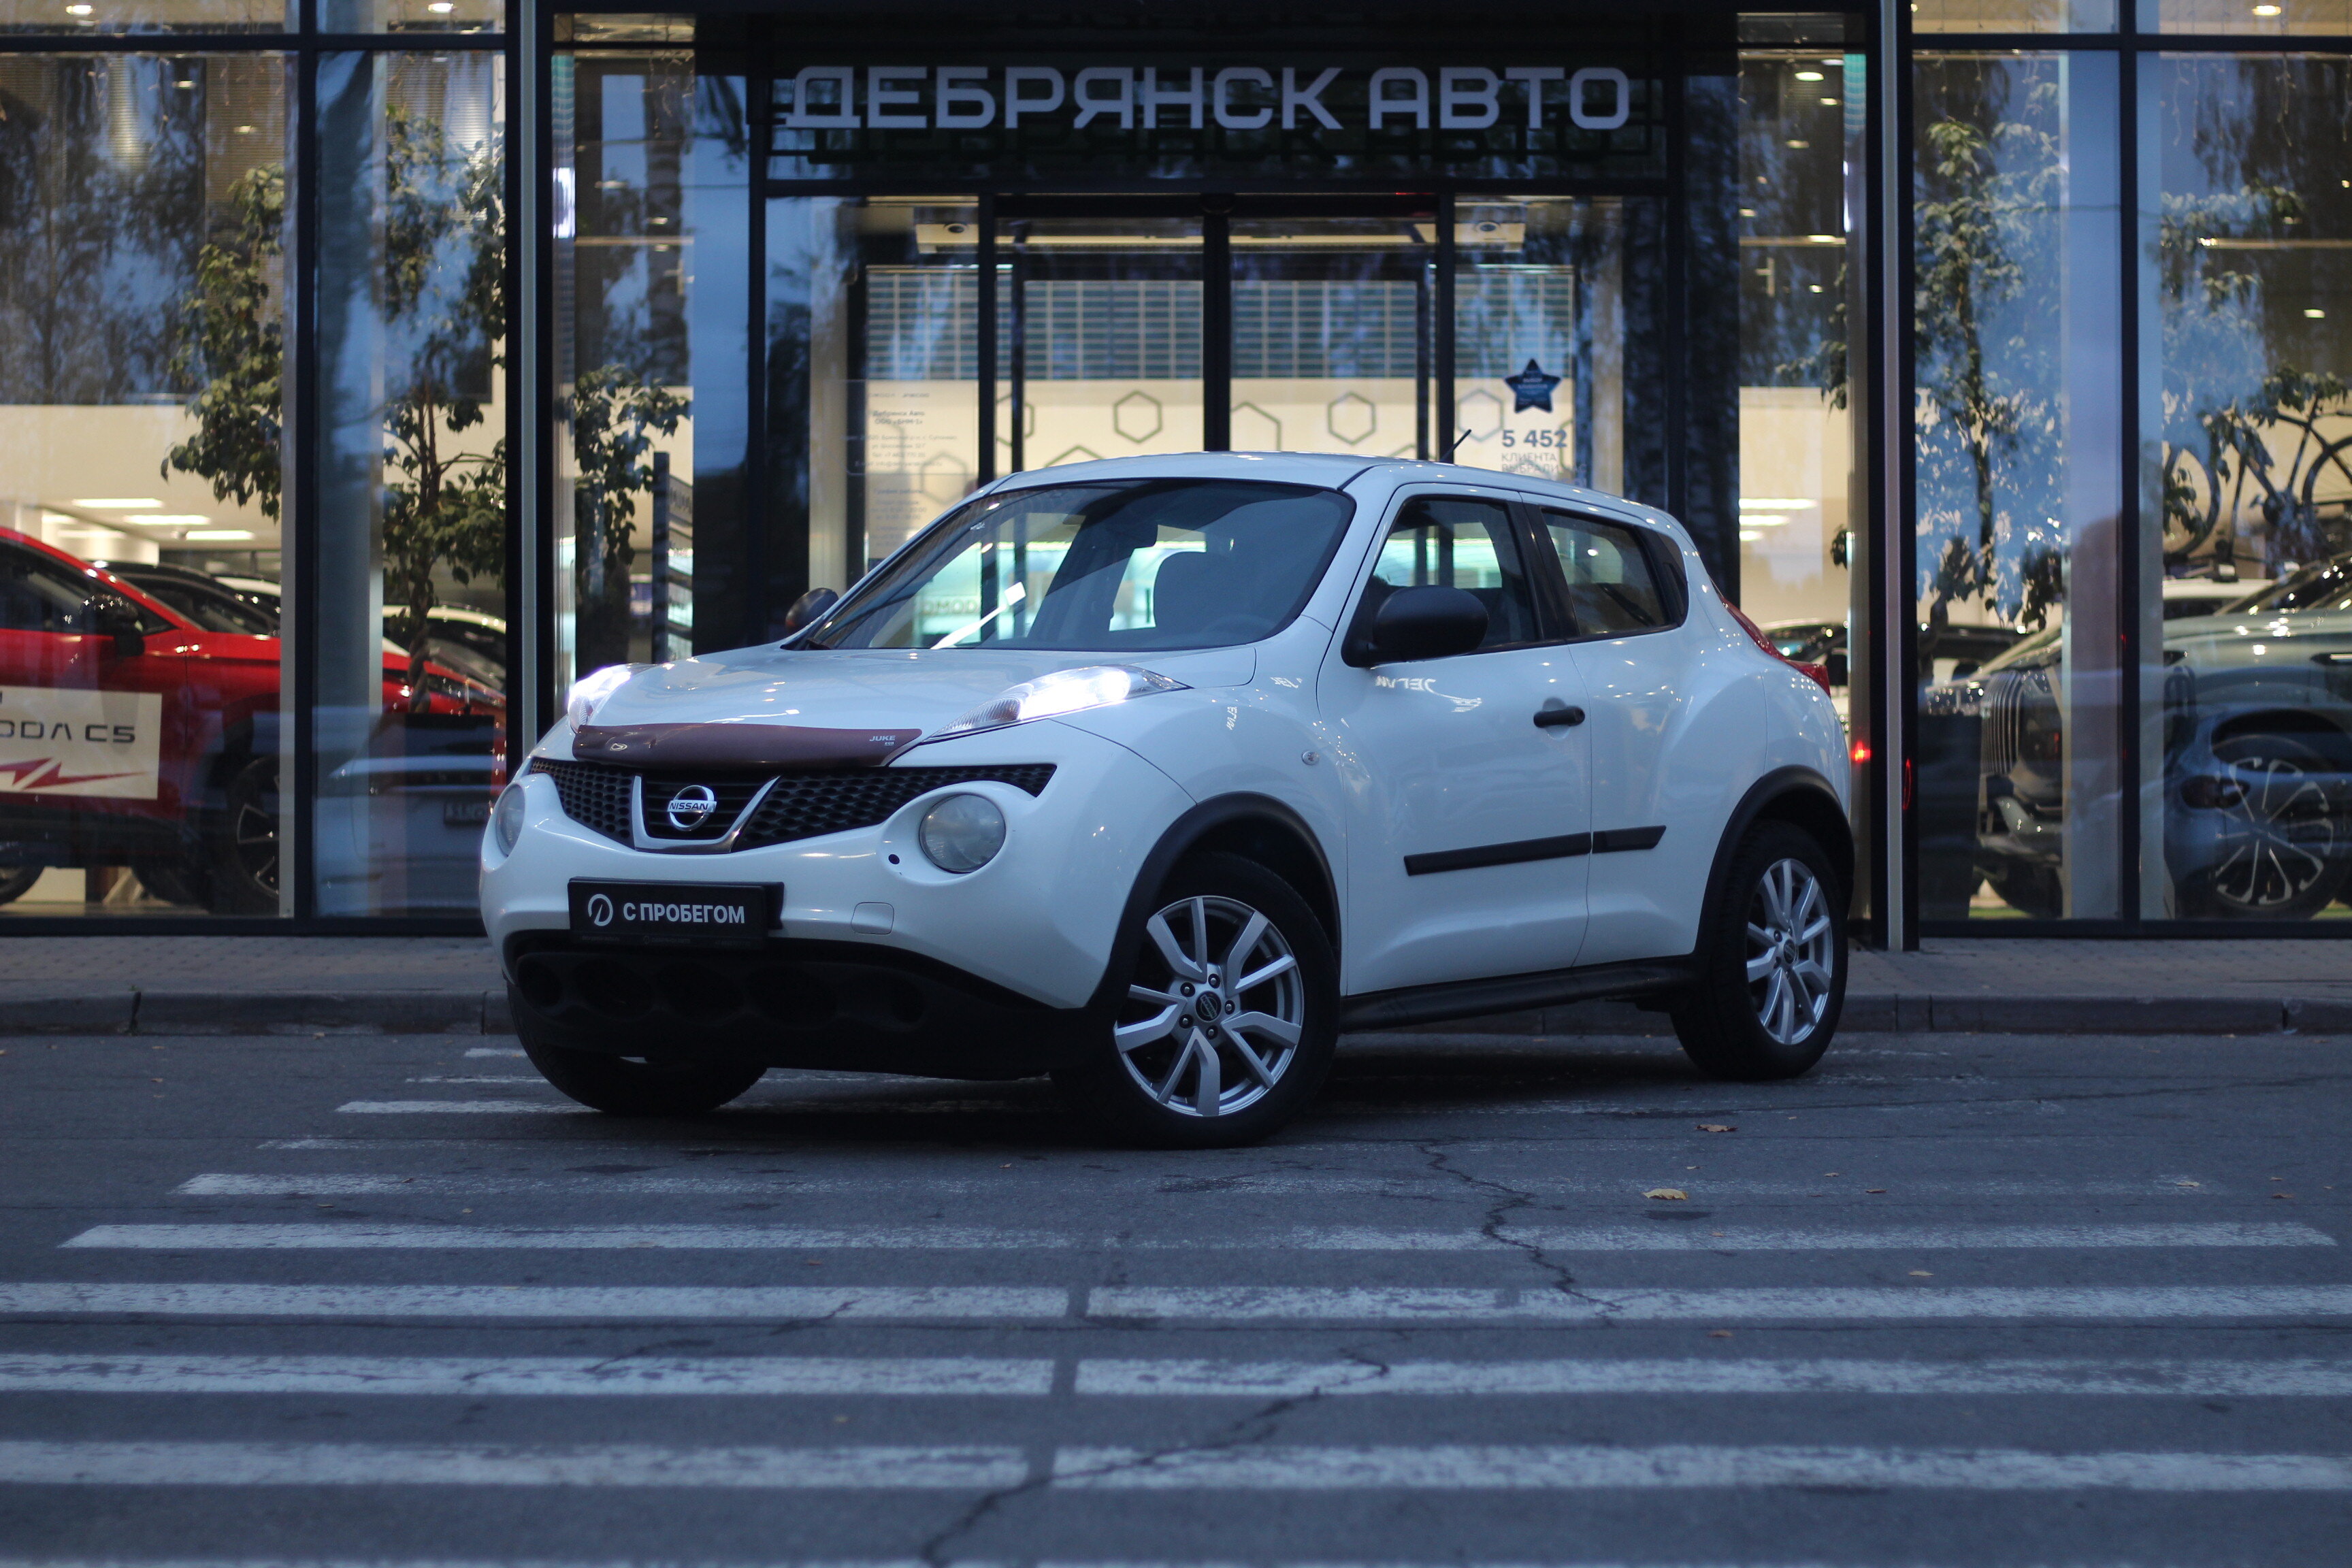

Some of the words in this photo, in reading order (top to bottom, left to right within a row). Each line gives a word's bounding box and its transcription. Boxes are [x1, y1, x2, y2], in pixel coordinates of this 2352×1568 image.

[786, 66, 1343, 129] ДЕБРЯНСК
[1369, 67, 1629, 129] АВТО
[1502, 429, 1515, 447] 5
[1524, 429, 1567, 447] 452
[1501, 453, 1557, 462] КЛИЕНТА
[85, 723, 135, 743] C5
[669, 802, 709, 811] NISSAN
[623, 902, 636, 921] С
[640, 902, 745, 924] ПРОБЕГОМ
